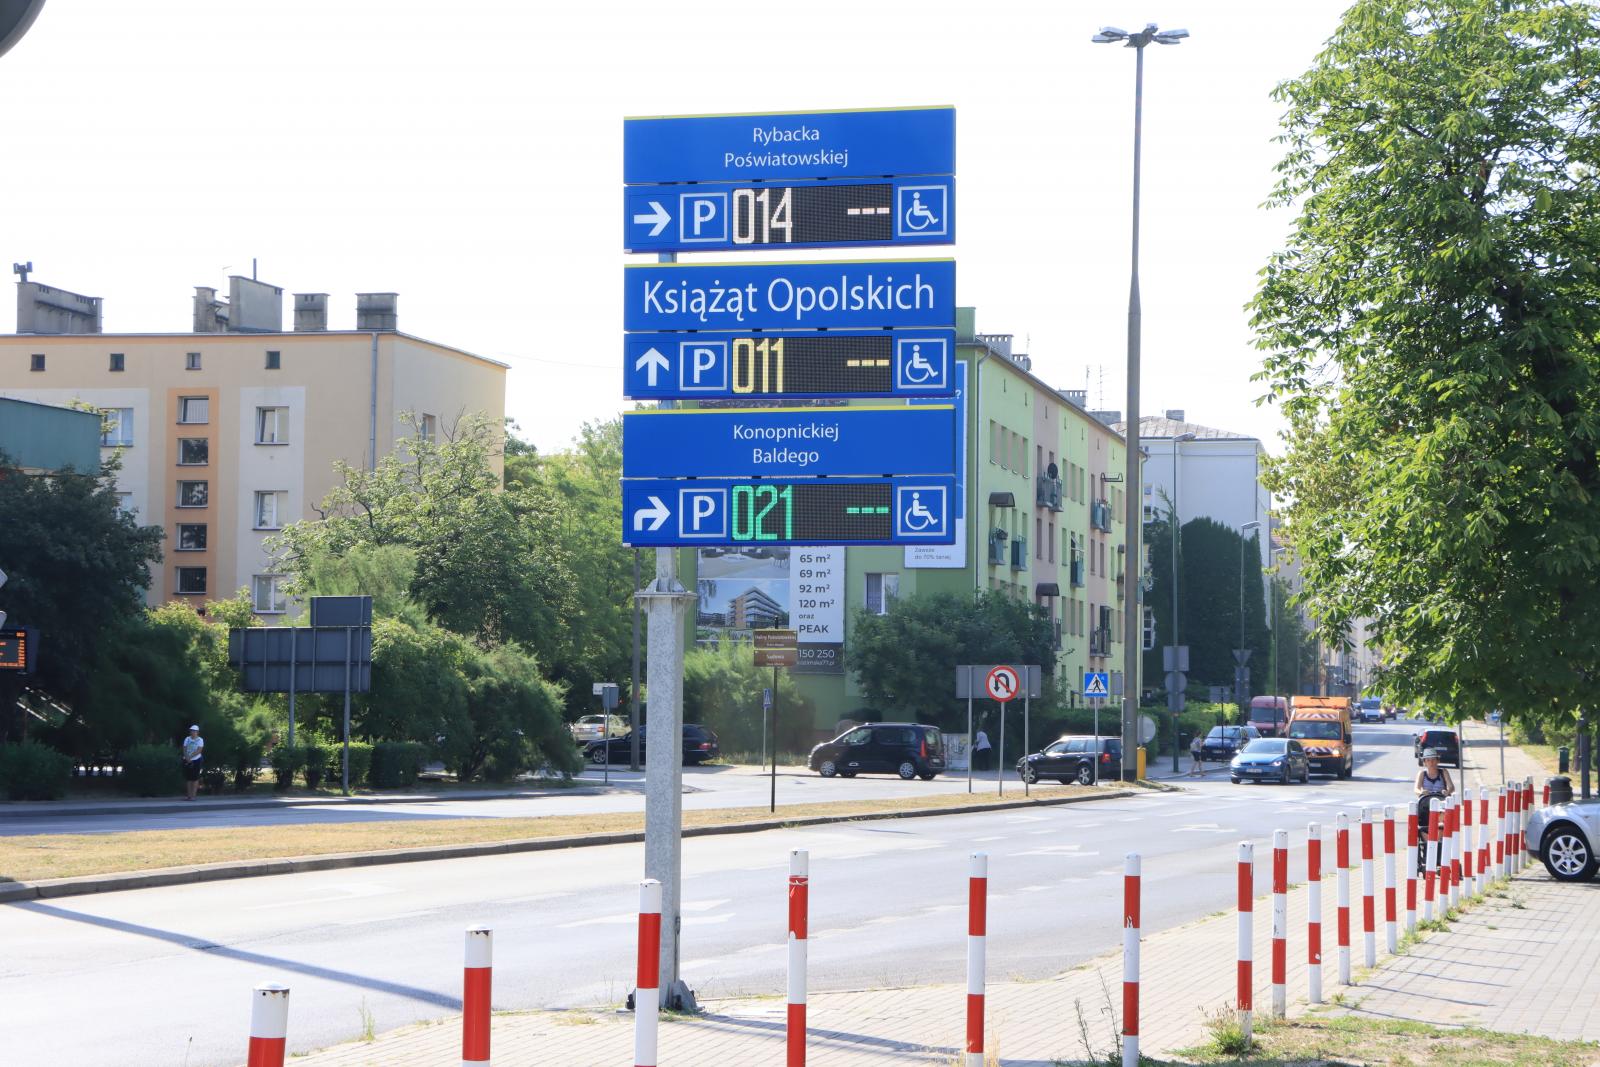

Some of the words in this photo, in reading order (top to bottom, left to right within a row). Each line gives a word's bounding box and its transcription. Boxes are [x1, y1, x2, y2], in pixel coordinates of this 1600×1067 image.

[753, 126, 820, 145] Rybacka
[725, 149, 848, 168] Poświatowskiej
[694, 200, 716, 235] P
[733, 187, 793, 244] 014
[644, 280, 758, 322] Książąt
[767, 274, 934, 321] Opolskich
[694, 349, 716, 384] P
[733, 337, 784, 393] 011
[733, 424, 839, 442] Konopnickiej
[753, 448, 819, 466] Baldego
[694, 495, 716, 531] P
[733, 485, 793, 541] 021
[799, 554, 813, 563] 65
[799, 569, 813, 578] 69
[799, 584, 813, 593] 92
[798, 599, 816, 608] 120
[798, 624, 829, 634] PEAK
[816, 649, 835, 658] 250
